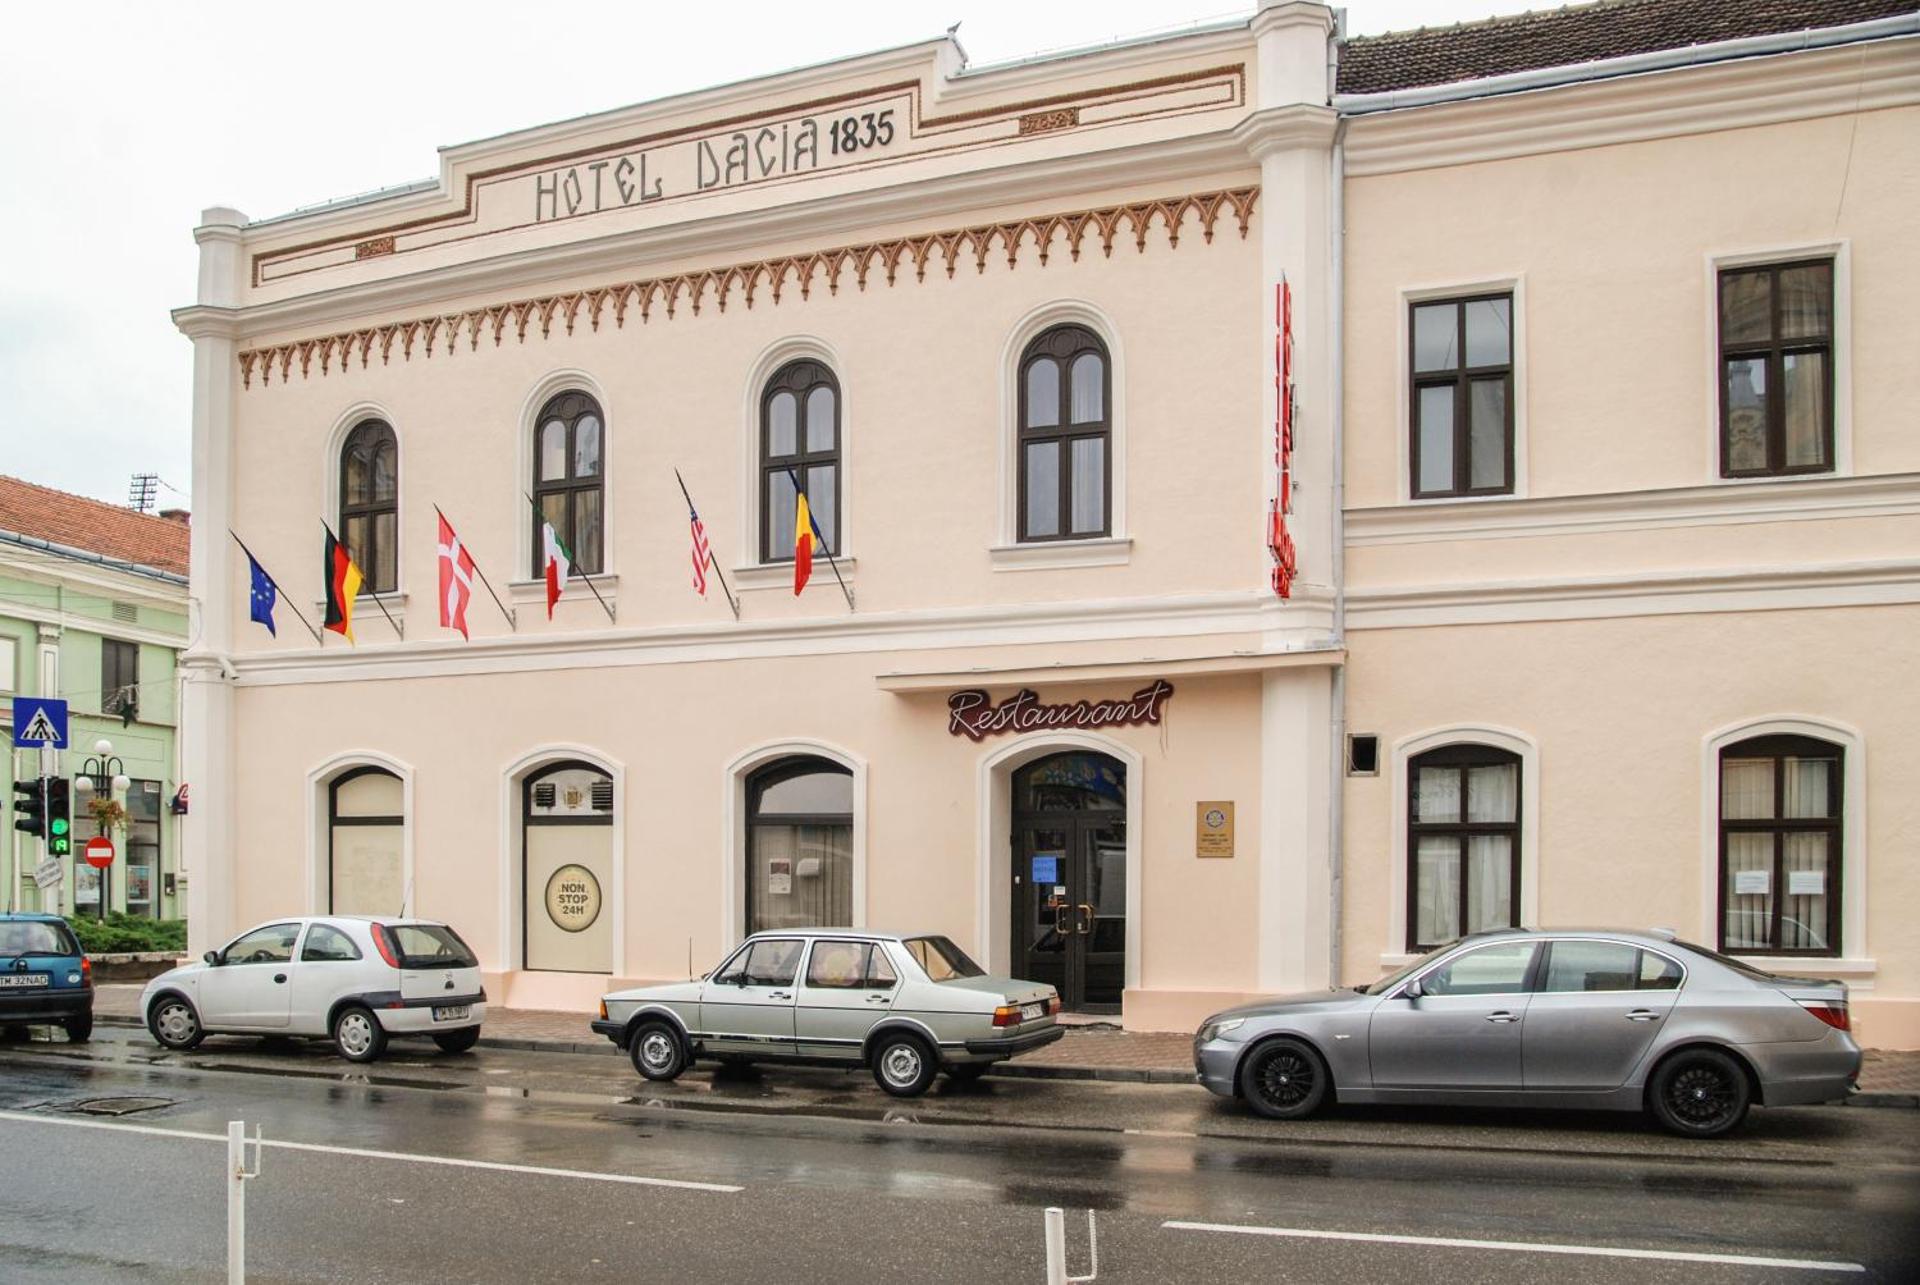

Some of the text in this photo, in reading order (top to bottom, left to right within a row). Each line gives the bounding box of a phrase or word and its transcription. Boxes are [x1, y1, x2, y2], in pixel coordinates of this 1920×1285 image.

[535, 109, 895, 221] HOTEL DACIA 1835
[949, 680, 1173, 740] Restaurant
[561, 883, 585, 893] NON
[558, 894, 589, 904] STOP
[562, 905, 584, 915] 24H
